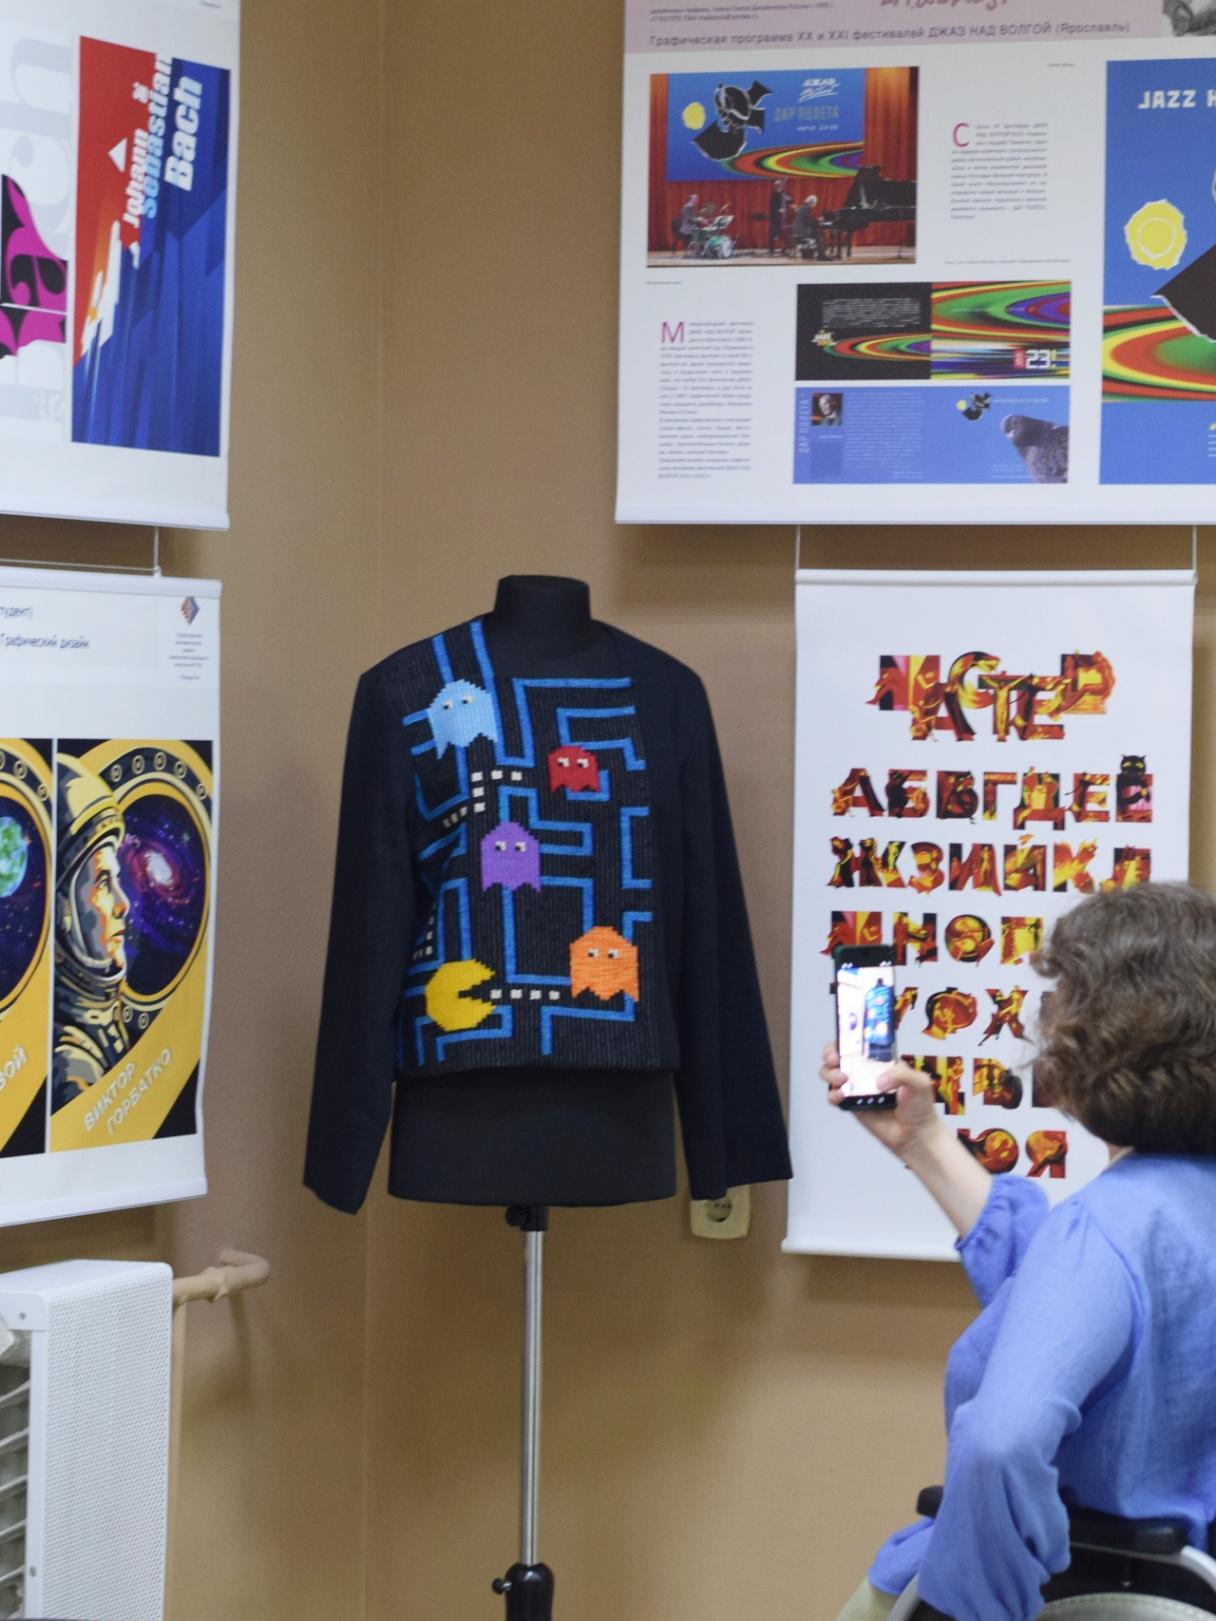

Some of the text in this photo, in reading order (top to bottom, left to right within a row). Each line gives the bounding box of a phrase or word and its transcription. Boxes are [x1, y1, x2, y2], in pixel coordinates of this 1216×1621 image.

[650, 35, 727, 47] Графическая
[731, 33, 793, 45] программа
[852, 28, 925, 41] фестивалей
[928, 26, 967, 38] ДЖАЗ
[969, 24, 996, 36] НАД
[999, 21, 1051, 35] ВОЛГОЙ
[1055, 20, 1131, 35] (Ярославль)
[164, 76, 203, 191] Bach
[1137, 89, 1196, 110] JAZZ
[84, 1061, 136, 1131] ВИКТОР
[106, 1047, 173, 1136] ГОРБАТКО
